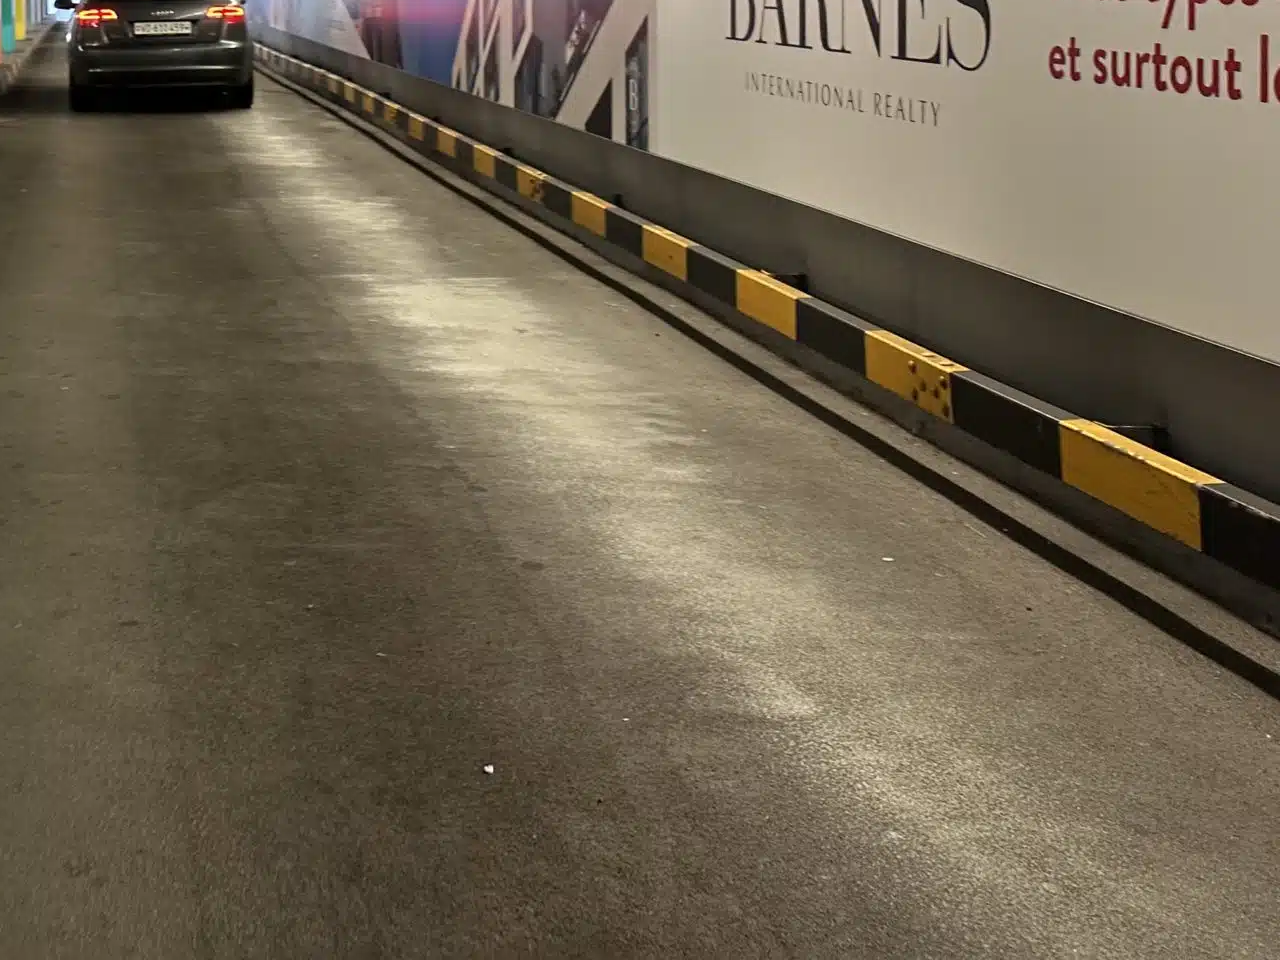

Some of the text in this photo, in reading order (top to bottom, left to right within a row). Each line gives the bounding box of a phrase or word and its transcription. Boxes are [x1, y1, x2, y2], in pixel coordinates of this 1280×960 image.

[745, 71, 941, 127] INTERNATIONAL REALTY
[1048, 34, 1280, 106] et surtout l
